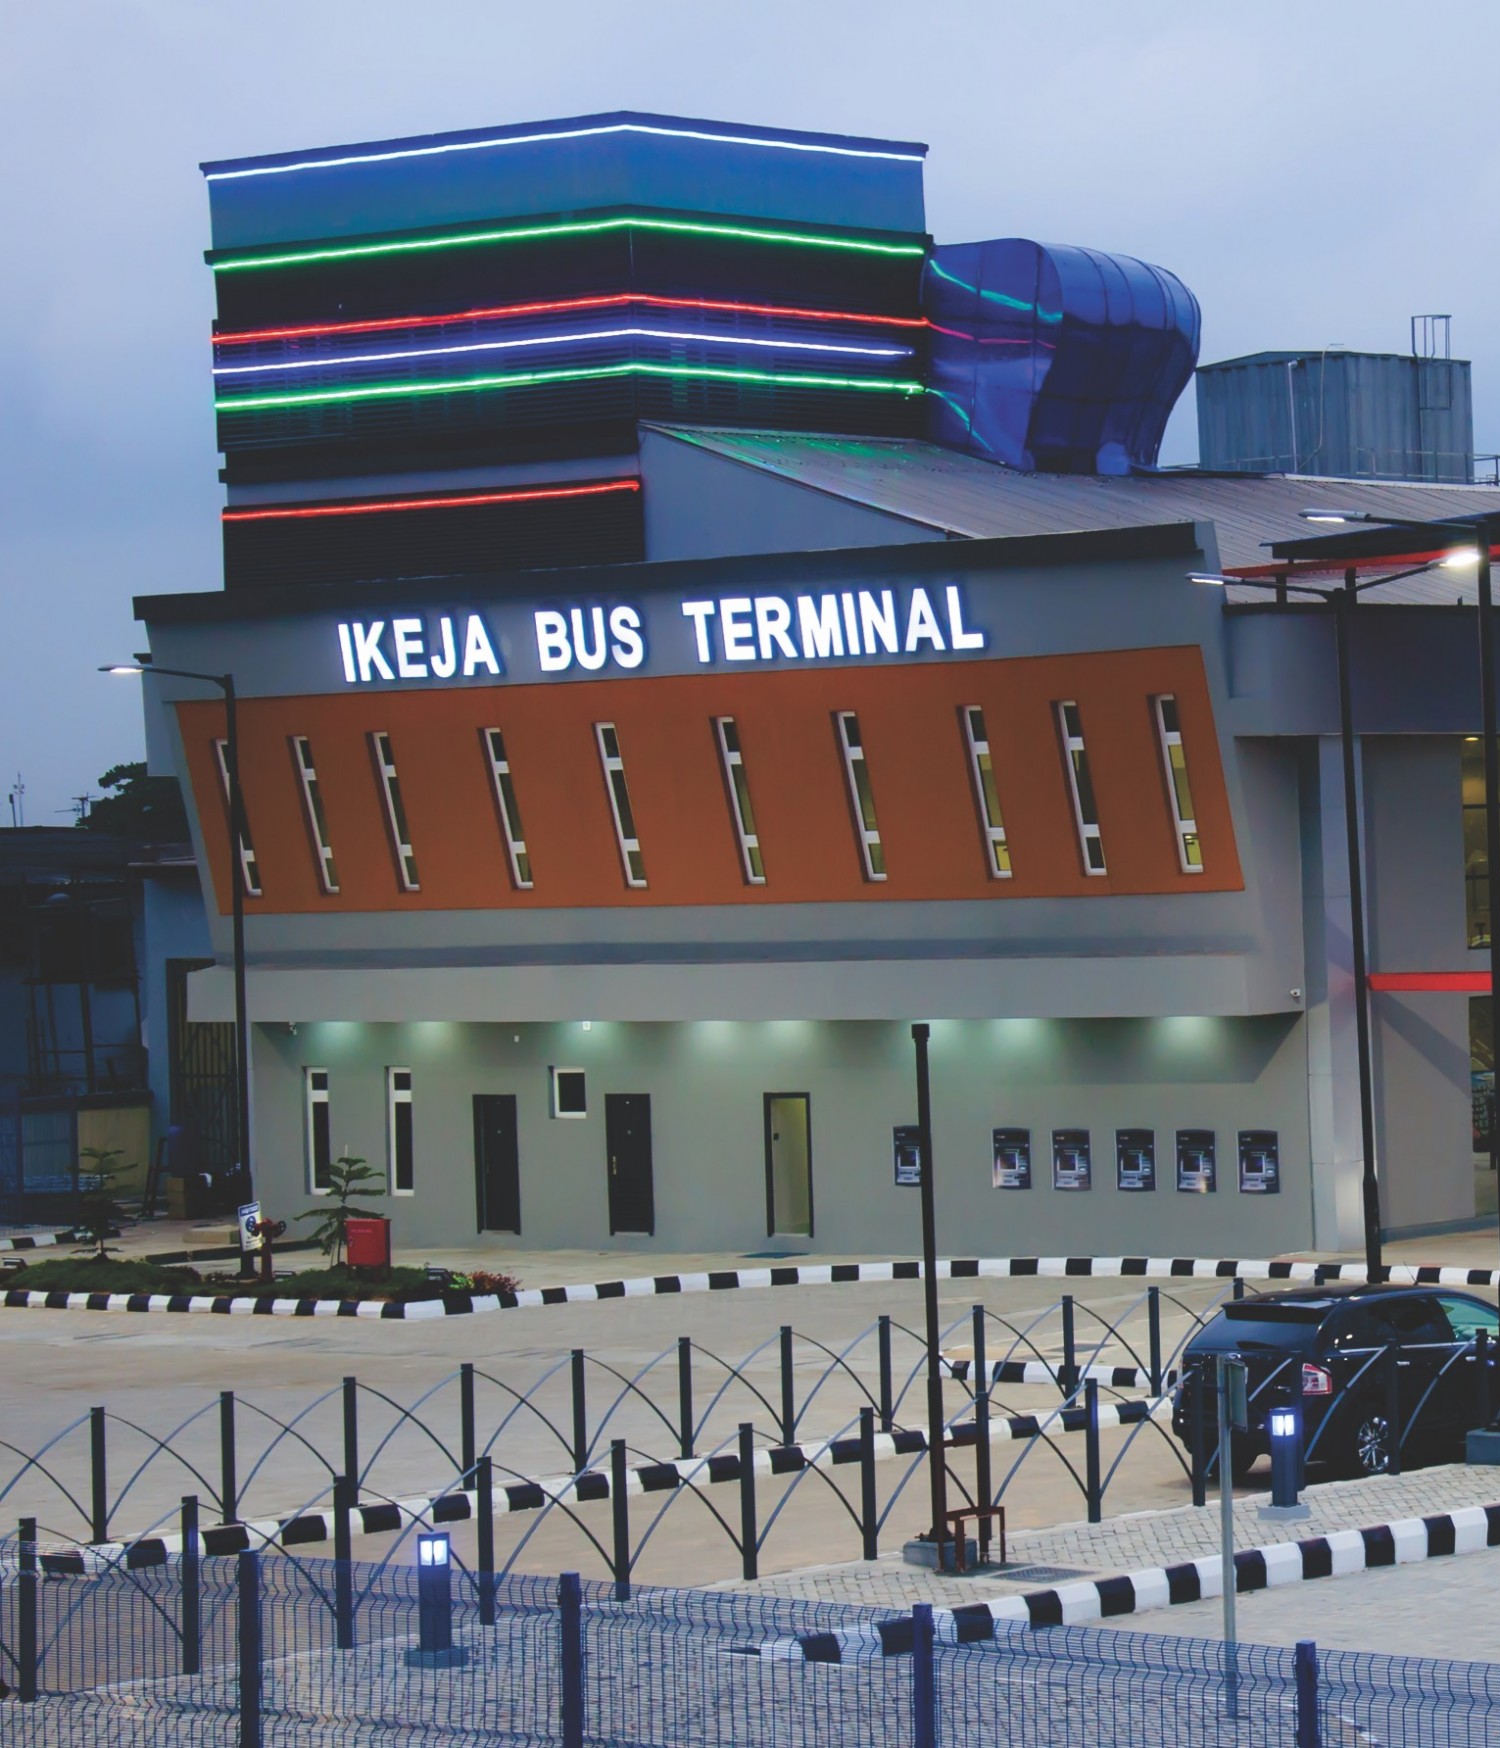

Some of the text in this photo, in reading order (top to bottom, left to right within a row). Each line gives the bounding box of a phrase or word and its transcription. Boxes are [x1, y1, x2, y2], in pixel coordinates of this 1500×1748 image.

[337, 585, 985, 683] IKEJA BUS TERMINAL
